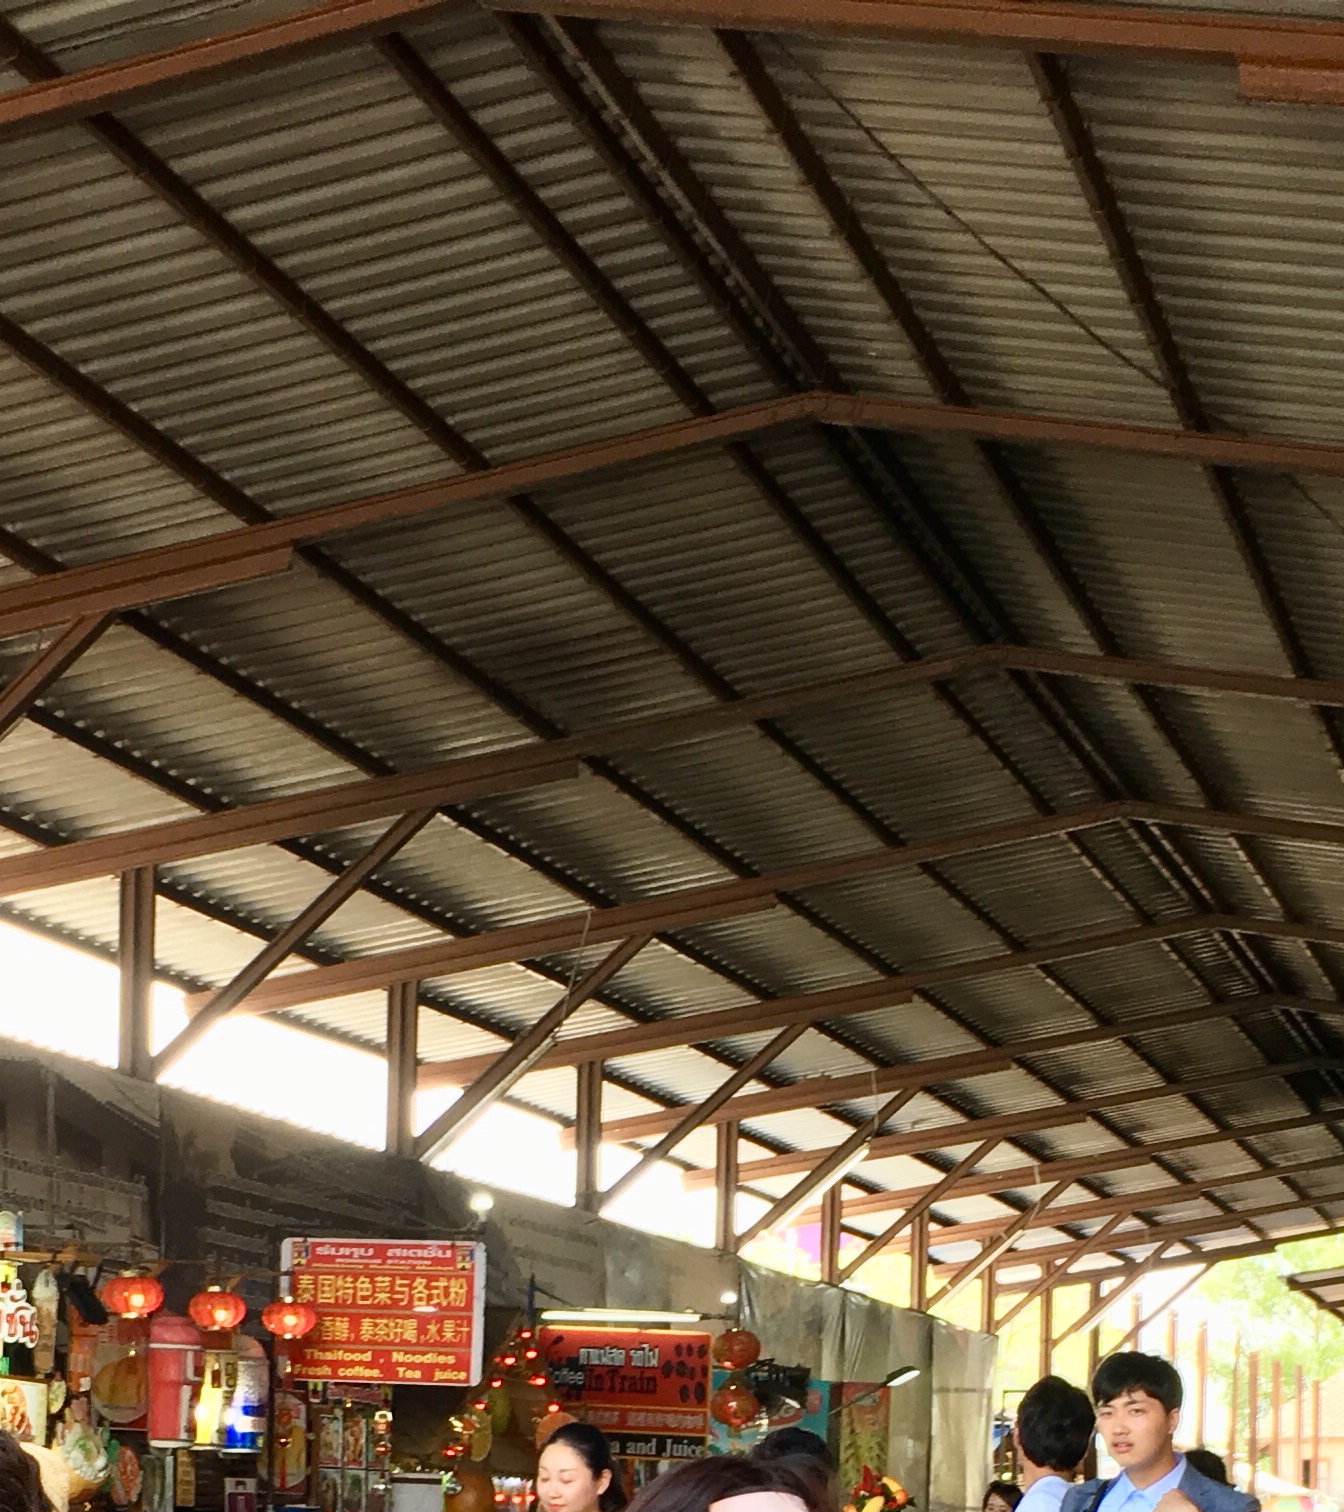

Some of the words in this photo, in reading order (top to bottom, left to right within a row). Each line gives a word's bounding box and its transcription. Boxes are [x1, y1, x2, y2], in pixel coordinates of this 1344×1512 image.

[297, 1274, 468, 1307] 泰国特色菜与各式粉
[392, 1351, 456, 1364] Noodles
[396, 1367, 422, 1379] Tea
[434, 1368, 467, 1381] juice
[626, 1439, 657, 1455] and
